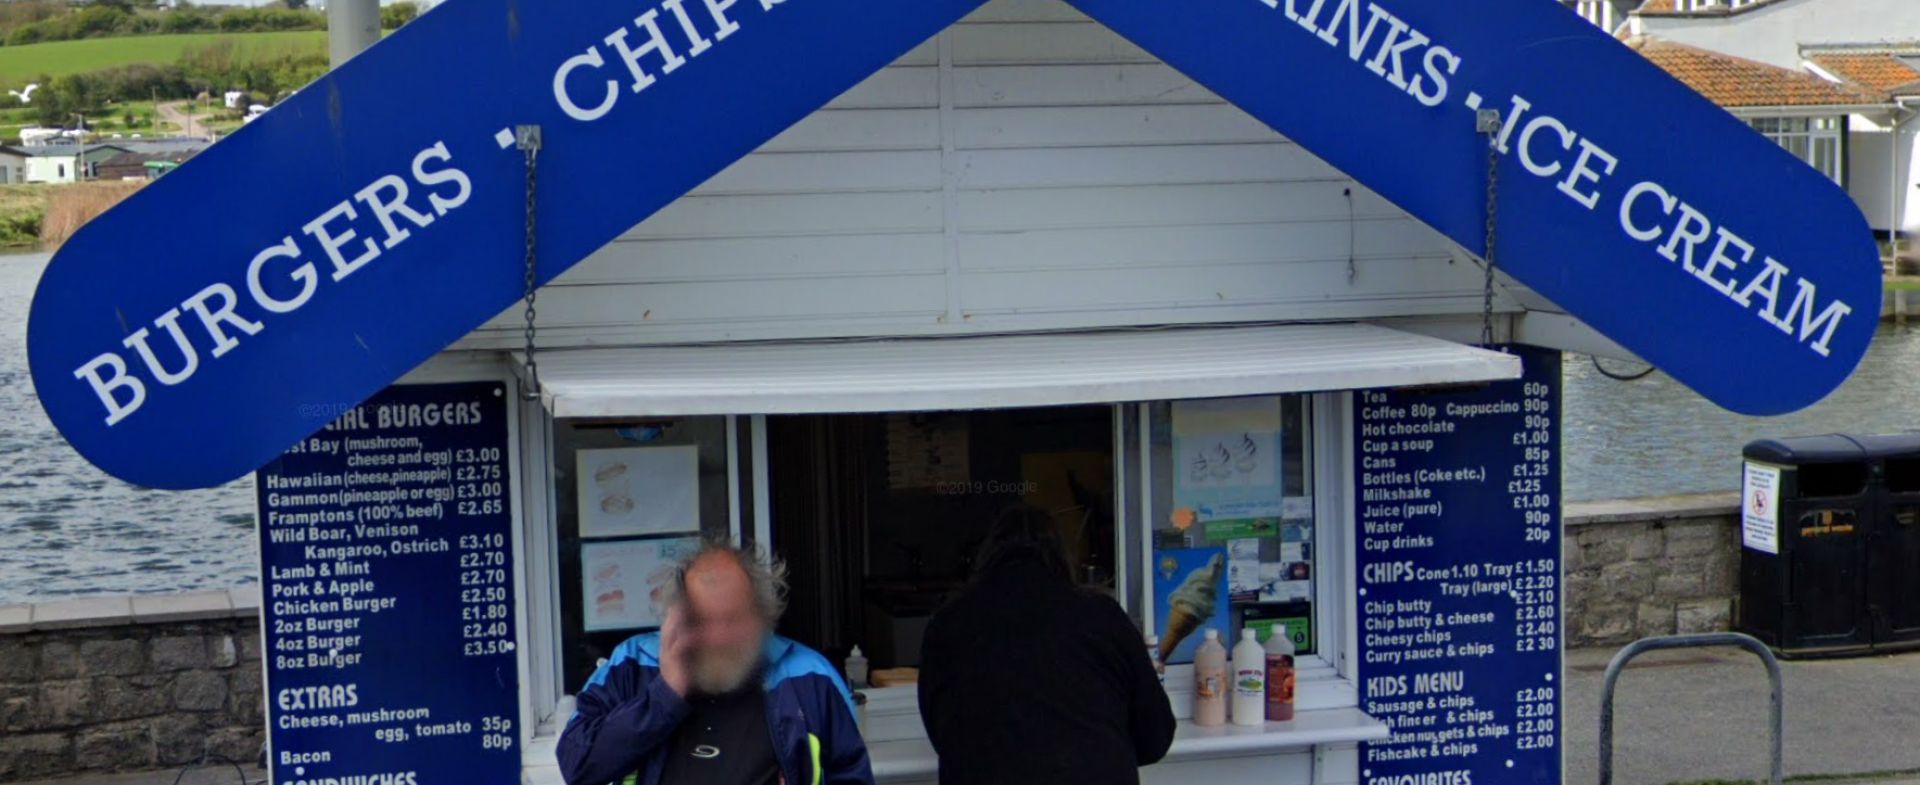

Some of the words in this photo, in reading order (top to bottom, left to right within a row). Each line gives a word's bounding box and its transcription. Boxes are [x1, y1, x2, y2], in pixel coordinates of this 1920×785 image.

[553, 0, 788, 121] CHIP
[1260, 0, 1461, 106] INKS
[1498, 94, 1617, 209] ICE
[1619, 180, 1851, 357] CREAM
[73, 140, 472, 427] BURGERS
[1362, 391, 1387, 403] Tea
[1524, 383, 1548, 397] 60p
[378, 402, 482, 428] BURGERS
[1362, 406, 1406, 420] Coffee
[1411, 404, 1436, 420] 80p
[1446, 400, 1520, 417] Cappuccino
[1524, 399, 1549, 413] 90p
[1363, 424, 1386, 436] Hot
[1389, 421, 1455, 435] chocolate
[1525, 415, 1549, 430] 90p
[310, 439, 339, 455] Bay
[345, 435, 423, 451] (mushroom,
[1363, 440, 1388, 455] Cup
[1392, 441, 1399, 450] a
[1402, 439, 1434, 452] soup
[1513, 431, 1549, 445] £1.00
[348, 452, 395, 465] cheese
[398, 450, 421, 463] and
[424, 449, 451, 465] egg)
[456, 447, 500, 462] £3.00
[1363, 456, 1396, 469] Cans
[1525, 448, 1549, 463] 85p
[267, 474, 342, 488] Hawaiian
[457, 465, 500, 480] £2.75
[1363, 472, 1411, 485] Bottles
[1415, 468, 1452, 485] (Coke
[1455, 466, 1486, 482] etc.)
[1513, 464, 1549, 477] £1.25
[269, 492, 339, 507] Gammon
[340, 488, 407, 506] (pineapple
[411, 488, 424, 498] or
[426, 484, 454, 501] egg)
[457, 483, 501, 498] £3.00
[1364, 487, 1431, 501] Milkshake
[1508, 479, 1540, 493] £1.25
[269, 510, 354, 526] Framptons
[358, 505, 403, 523] (100%
[406, 503, 443, 518] beef)
[458, 500, 502, 514] £2.65
[1363, 506, 1400, 518] Juice
[1403, 501, 1442, 518] (pure)
[1514, 495, 1550, 508] £1.00
[271, 527, 305, 542] Wild
[309, 526, 351, 541] Boar,
[355, 524, 418, 538] Venison
[1364, 521, 1404, 534] Water
[1525, 511, 1550, 526] 90p
[305, 543, 387, 560] Kangaroo,
[391, 538, 449, 553] Ostrich
[460, 534, 503, 549] £3.10
[1364, 538, 1389, 552] Cup
[1392, 536, 1434, 549] drinks
[1525, 528, 1550, 543] 20p
[272, 565, 315, 580] Lamb
[320, 564, 331, 576] &
[335, 561, 370, 575] Mint
[460, 552, 504, 567] £2.70
[1363, 561, 1414, 584] CHIPS
[1417, 568, 1450, 580] Cone
[1451, 565, 1478, 578] 1.10
[1484, 563, 1513, 578] Tray
[273, 583, 309, 597] Pork
[314, 581, 325, 594] &
[329, 579, 374, 596] Apple
[461, 570, 505, 585] £2.70
[1440, 583, 1469, 597] Tray
[1472, 580, 1512, 596] (large)
[274, 600, 339, 615] Chicken
[343, 596, 396, 613] Burger
[462, 588, 505, 602] £2.50
[1365, 602, 1394, 615] Chip
[1397, 600, 1431, 613] butty
[275, 620, 302, 634] 2oz
[306, 617, 360, 632] Burger
[463, 605, 506, 620] £1.80
[1365, 618, 1394, 632] Chip
[1398, 616, 1431, 630] butty
[1435, 613, 1445, 626] &
[1447, 612, 1494, 625] cheese
[276, 638, 304, 651] 4oz
[307, 635, 360, 650] Burger
[464, 623, 507, 638] £2.40
[1366, 633, 1413, 647] Cheesy
[1416, 631, 1451, 644] chips
[277, 655, 304, 669] 8oz
[308, 653, 361, 668] Burger
[464, 640, 507, 655] £3.50
[1366, 650, 1402, 664] Curry
[1404, 648, 1443, 660] sauce
[1447, 645, 1456, 657] &
[1459, 643, 1494, 658] chips
[1367, 675, 1407, 697] KIDS
[1414, 671, 1464, 694] MENU
[278, 684, 358, 710] EXTRAS
[1368, 700, 1424, 714] Sausage
[1427, 696, 1436, 709] &
[1439, 694, 1474, 708] chips
[1517, 688, 1553, 702] £2.00
[280, 714, 343, 729] Cheese,
[347, 708, 429, 724] mushroom
[1446, 711, 1456, 723] &
[1459, 709, 1494, 724] chips
[1517, 703, 1553, 717] £2.00
[375, 729, 409, 742] egg,
[416, 721, 471, 736] tomato
[482, 716, 511, 732] 35p
[1467, 725, 1476, 737] &
[1478, 723, 1509, 738] chips
[1517, 719, 1553, 733] £2.00
[281, 751, 331, 764] Bacon
[483, 734, 512, 750] 80p
[1368, 746, 1427, 762] Fishcake
[1430, 744, 1440, 757] &
[1443, 743, 1478, 756] chips
[1517, 734, 1553, 749] £2.00
